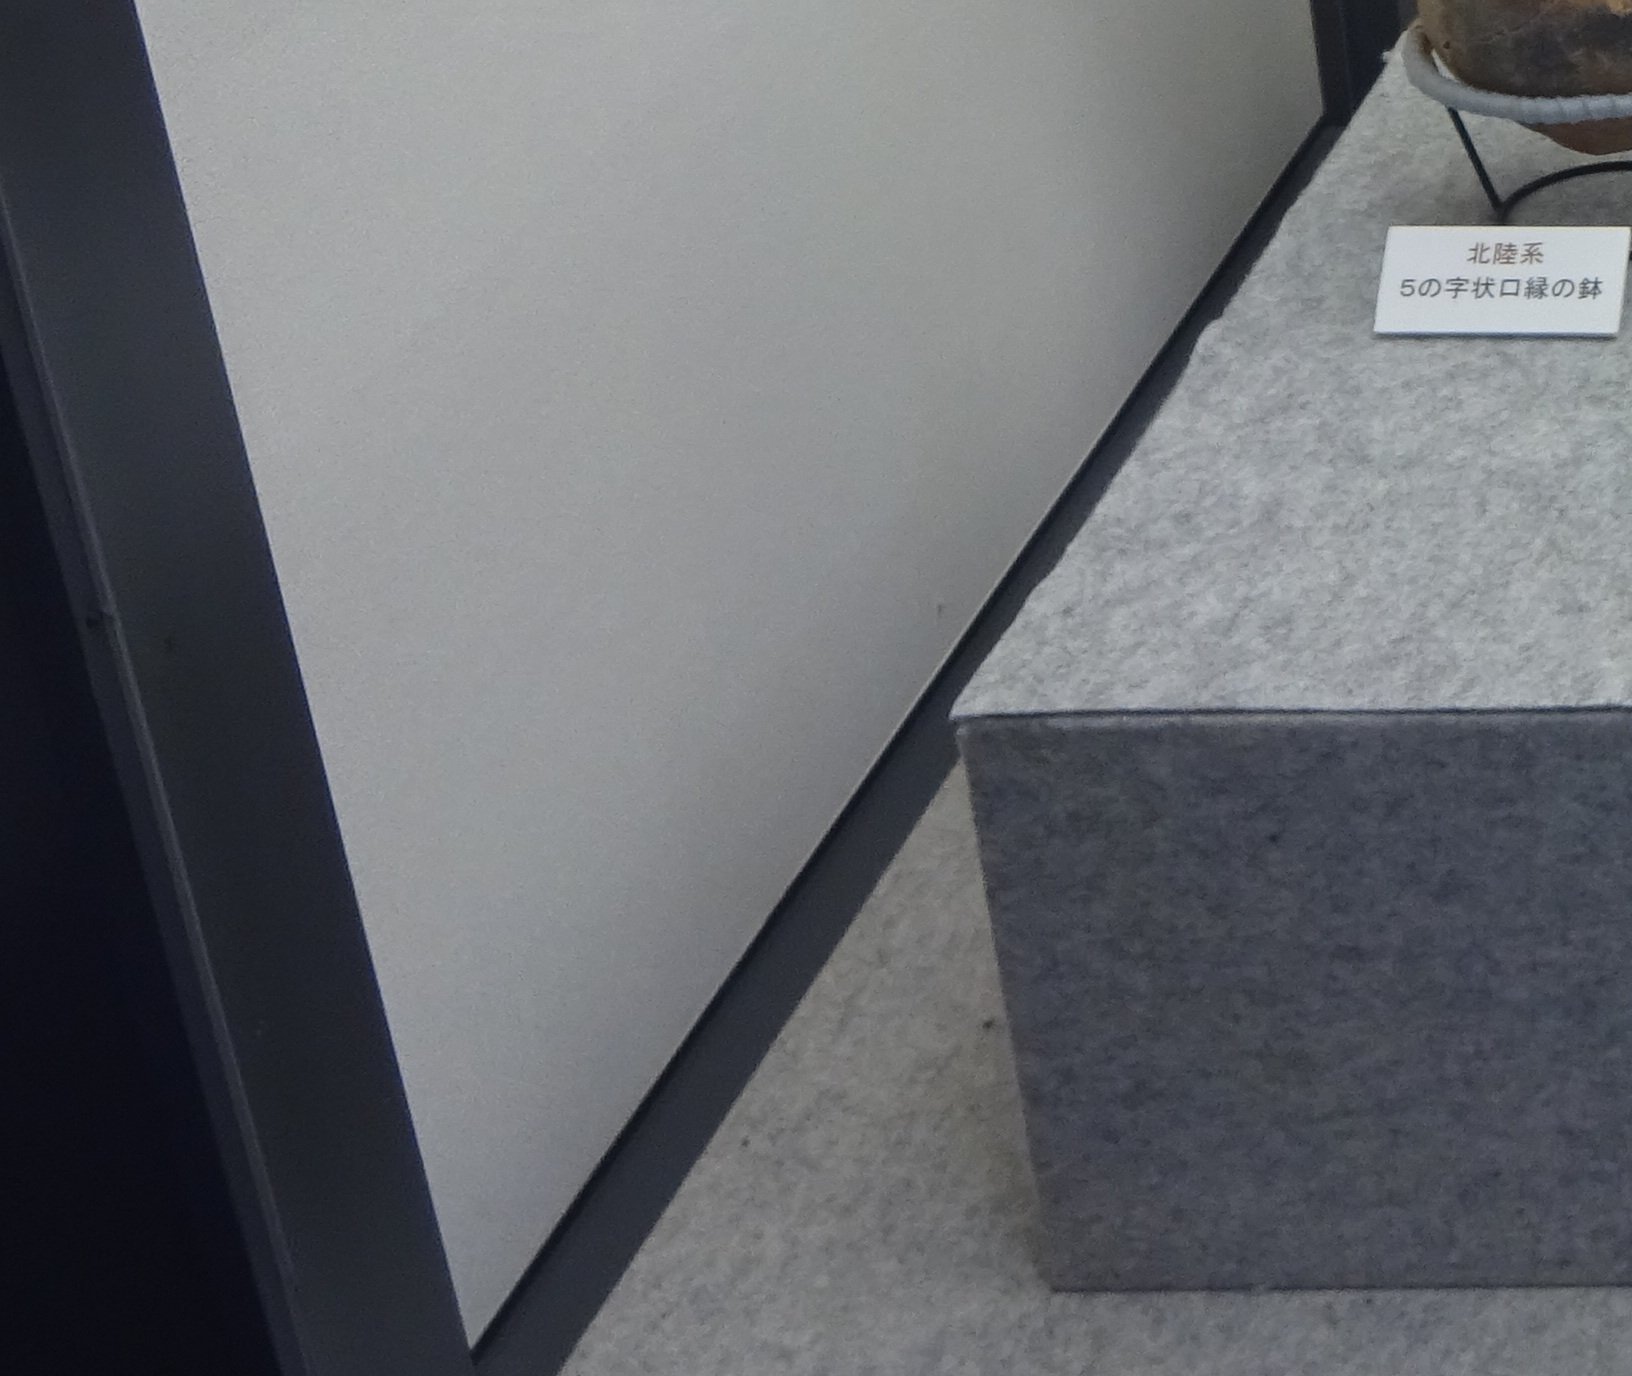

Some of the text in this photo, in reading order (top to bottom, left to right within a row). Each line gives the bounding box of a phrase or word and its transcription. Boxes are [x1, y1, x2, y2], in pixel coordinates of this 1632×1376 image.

[1466, 242, 1545, 265] 北陸系
[1400, 277, 1603, 300] 5の字状口縁の鉢
